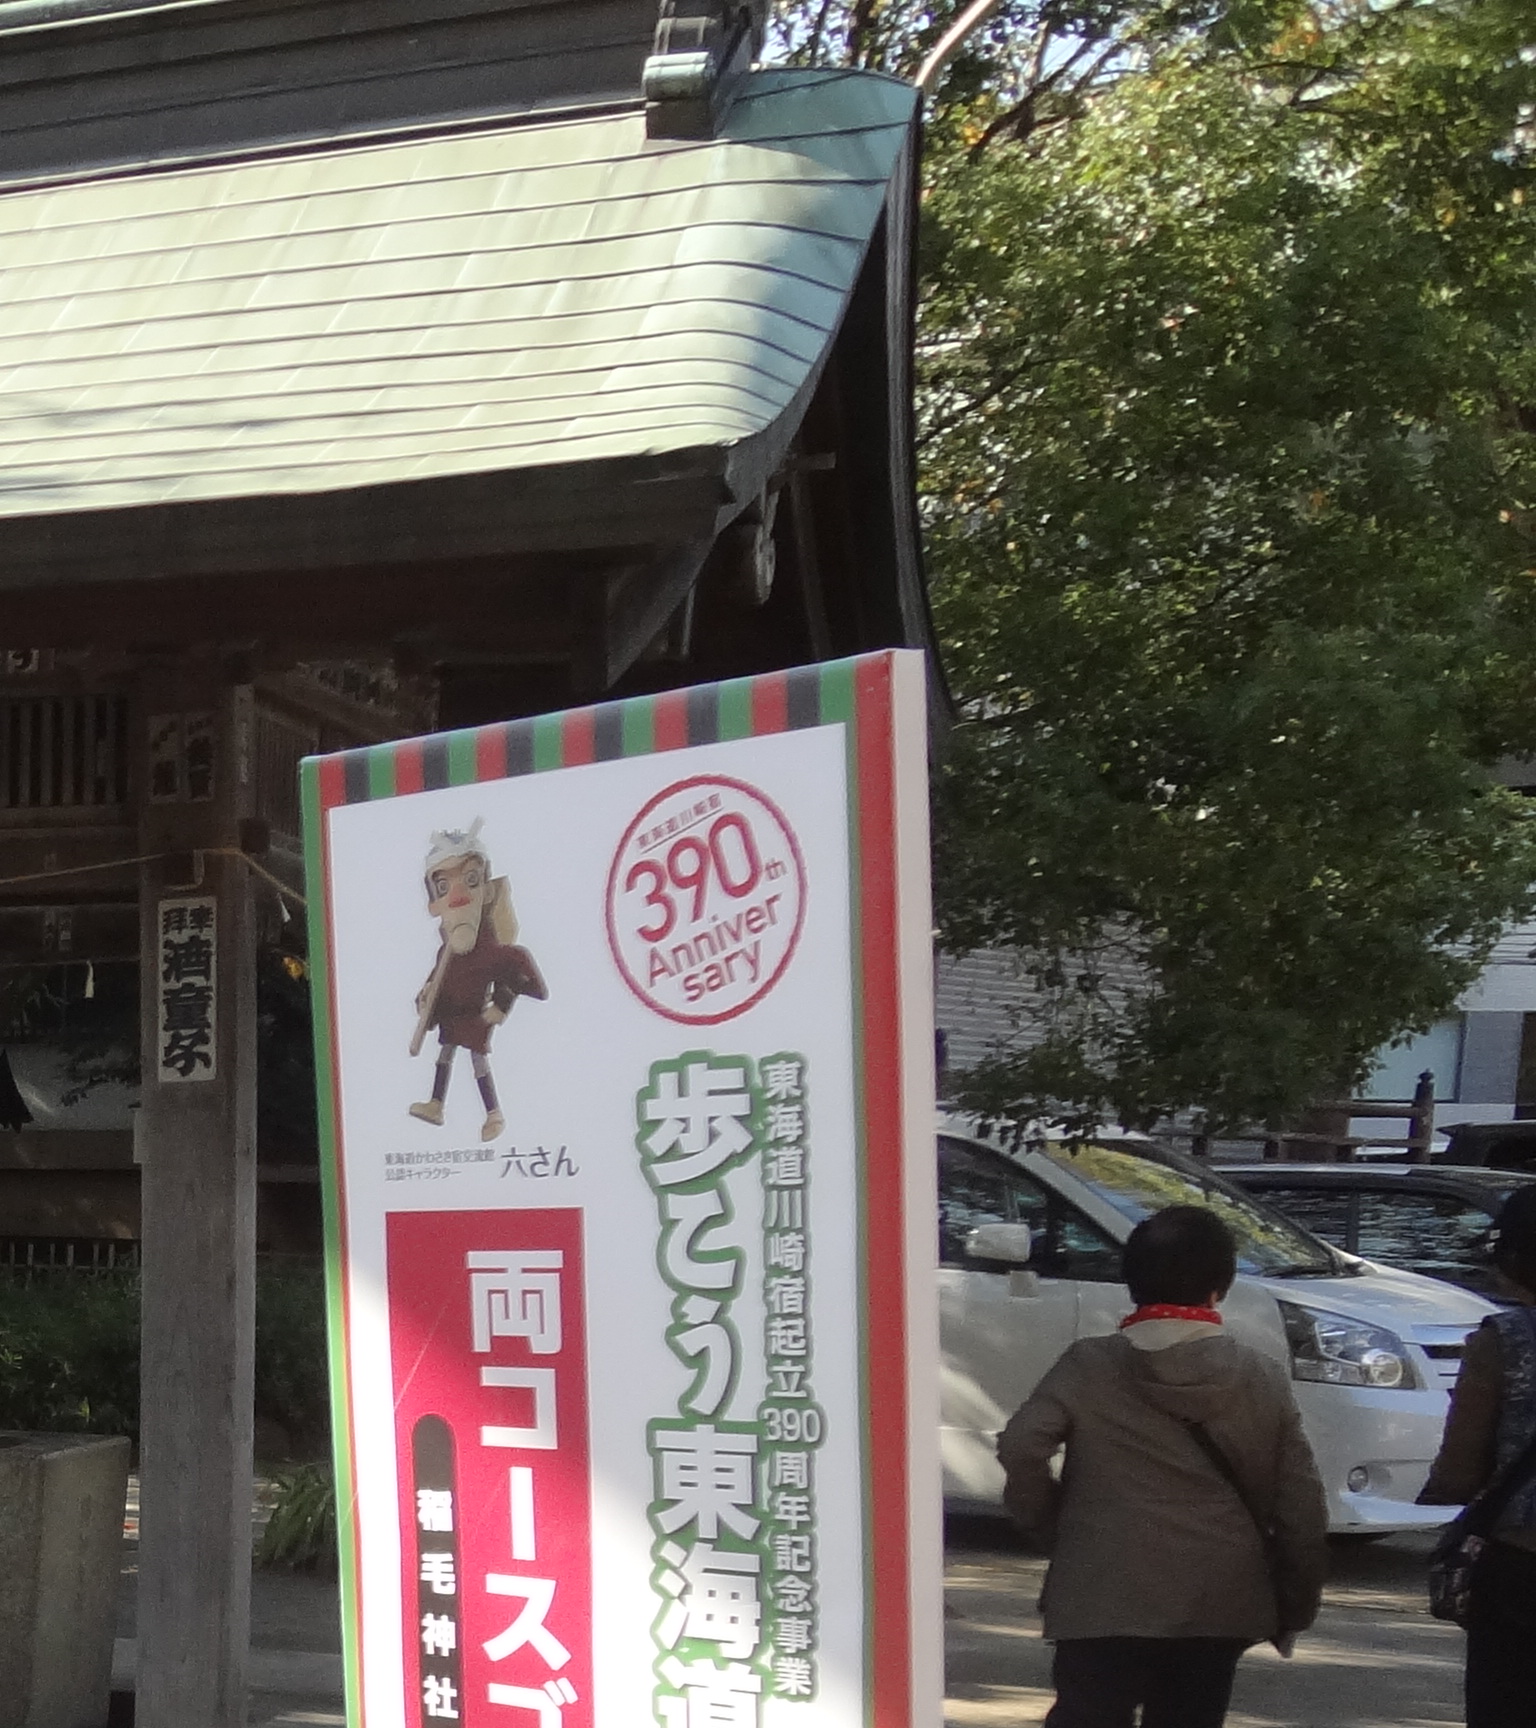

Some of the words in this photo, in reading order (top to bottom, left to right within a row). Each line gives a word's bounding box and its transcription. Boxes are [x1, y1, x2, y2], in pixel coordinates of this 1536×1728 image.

[649, 892, 783, 988] Anniver
[683, 940, 762, 1003] sary
[501, 1146, 580, 1178] 六さん
[762, 1058, 822, 1697] 東海道川崎宿起立390周年記念事業
[415, 1488, 460, 1720] 稲毛神社
